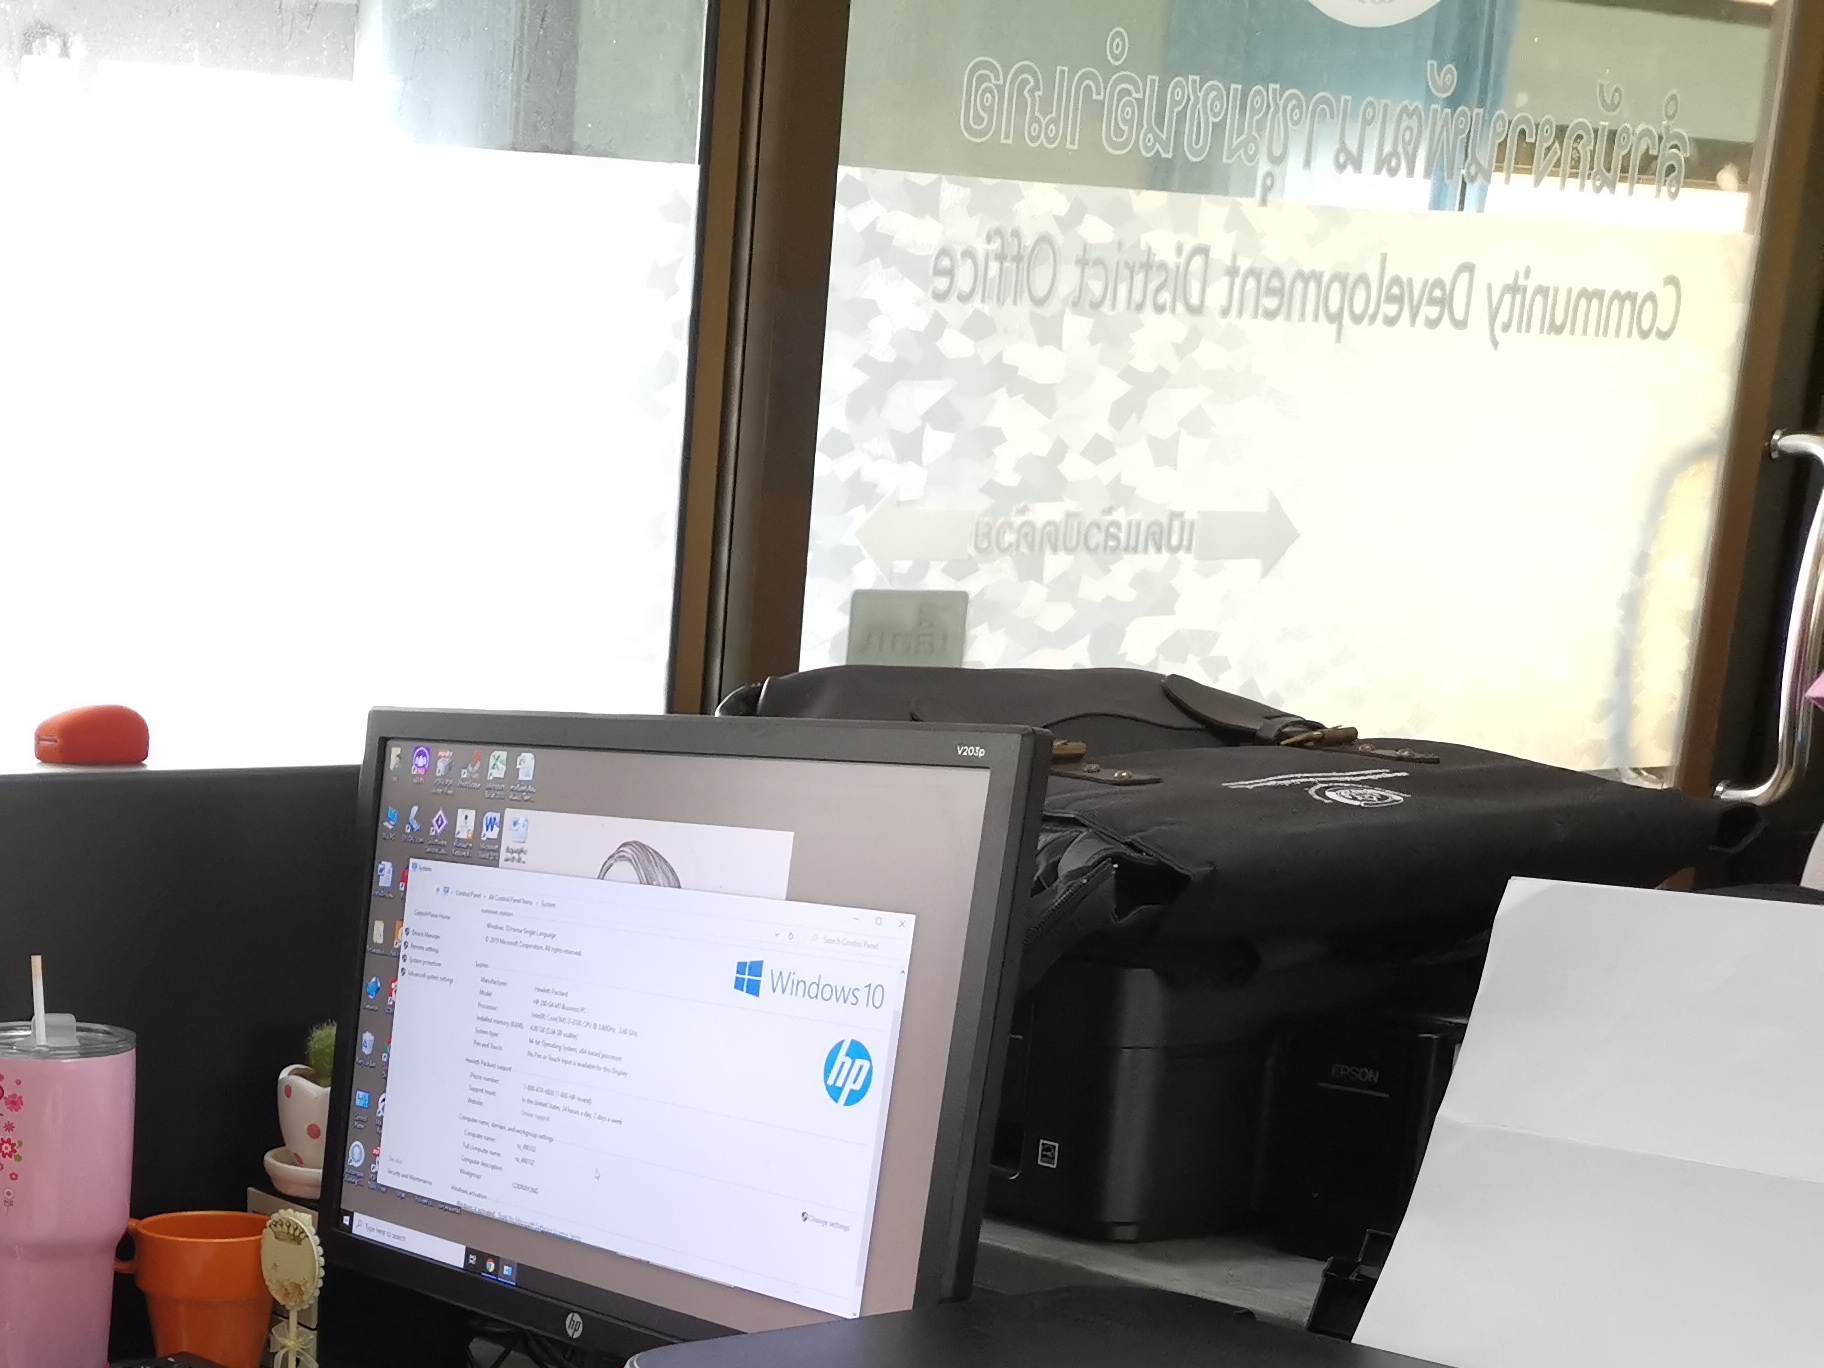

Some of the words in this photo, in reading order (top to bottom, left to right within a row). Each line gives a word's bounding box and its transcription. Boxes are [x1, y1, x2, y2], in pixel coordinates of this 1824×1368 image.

[956, 744, 986, 758] V203p
[770, 968, 860, 1006] Windows
[864, 983, 885, 1010] 10
[824, 1038, 873, 1107] hp
[1331, 1063, 1380, 1083] EPSON
[566, 1312, 584, 1339] hp
